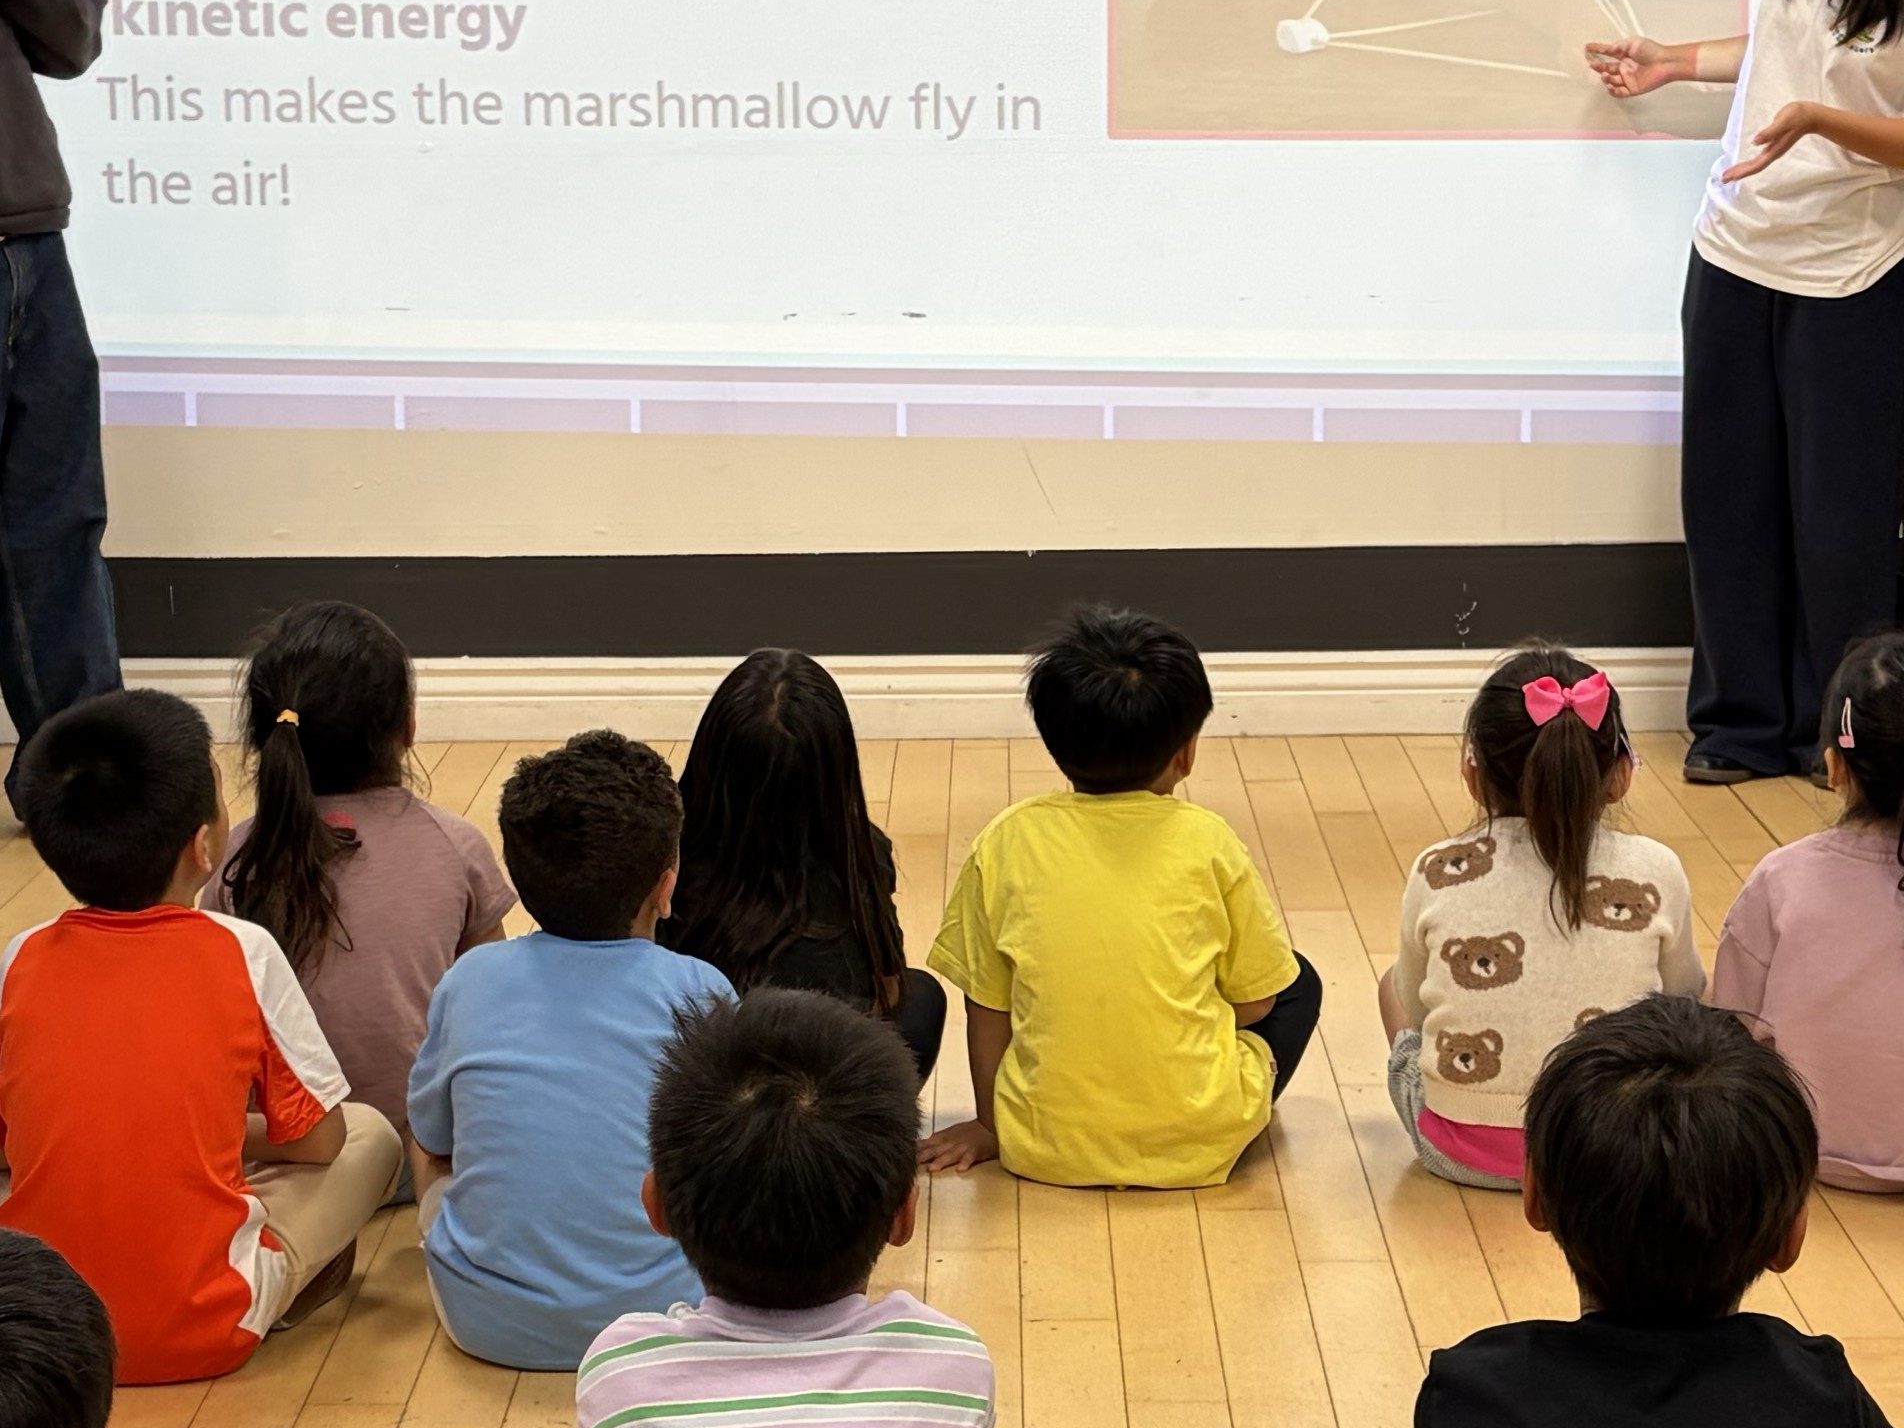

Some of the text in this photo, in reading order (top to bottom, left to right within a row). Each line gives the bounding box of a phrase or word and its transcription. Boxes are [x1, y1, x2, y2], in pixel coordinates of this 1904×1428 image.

[326, 2, 528, 52] energy
[97, 73, 1042, 142] This makes the marshmallow fly in
[101, 158, 291, 207] the air!
